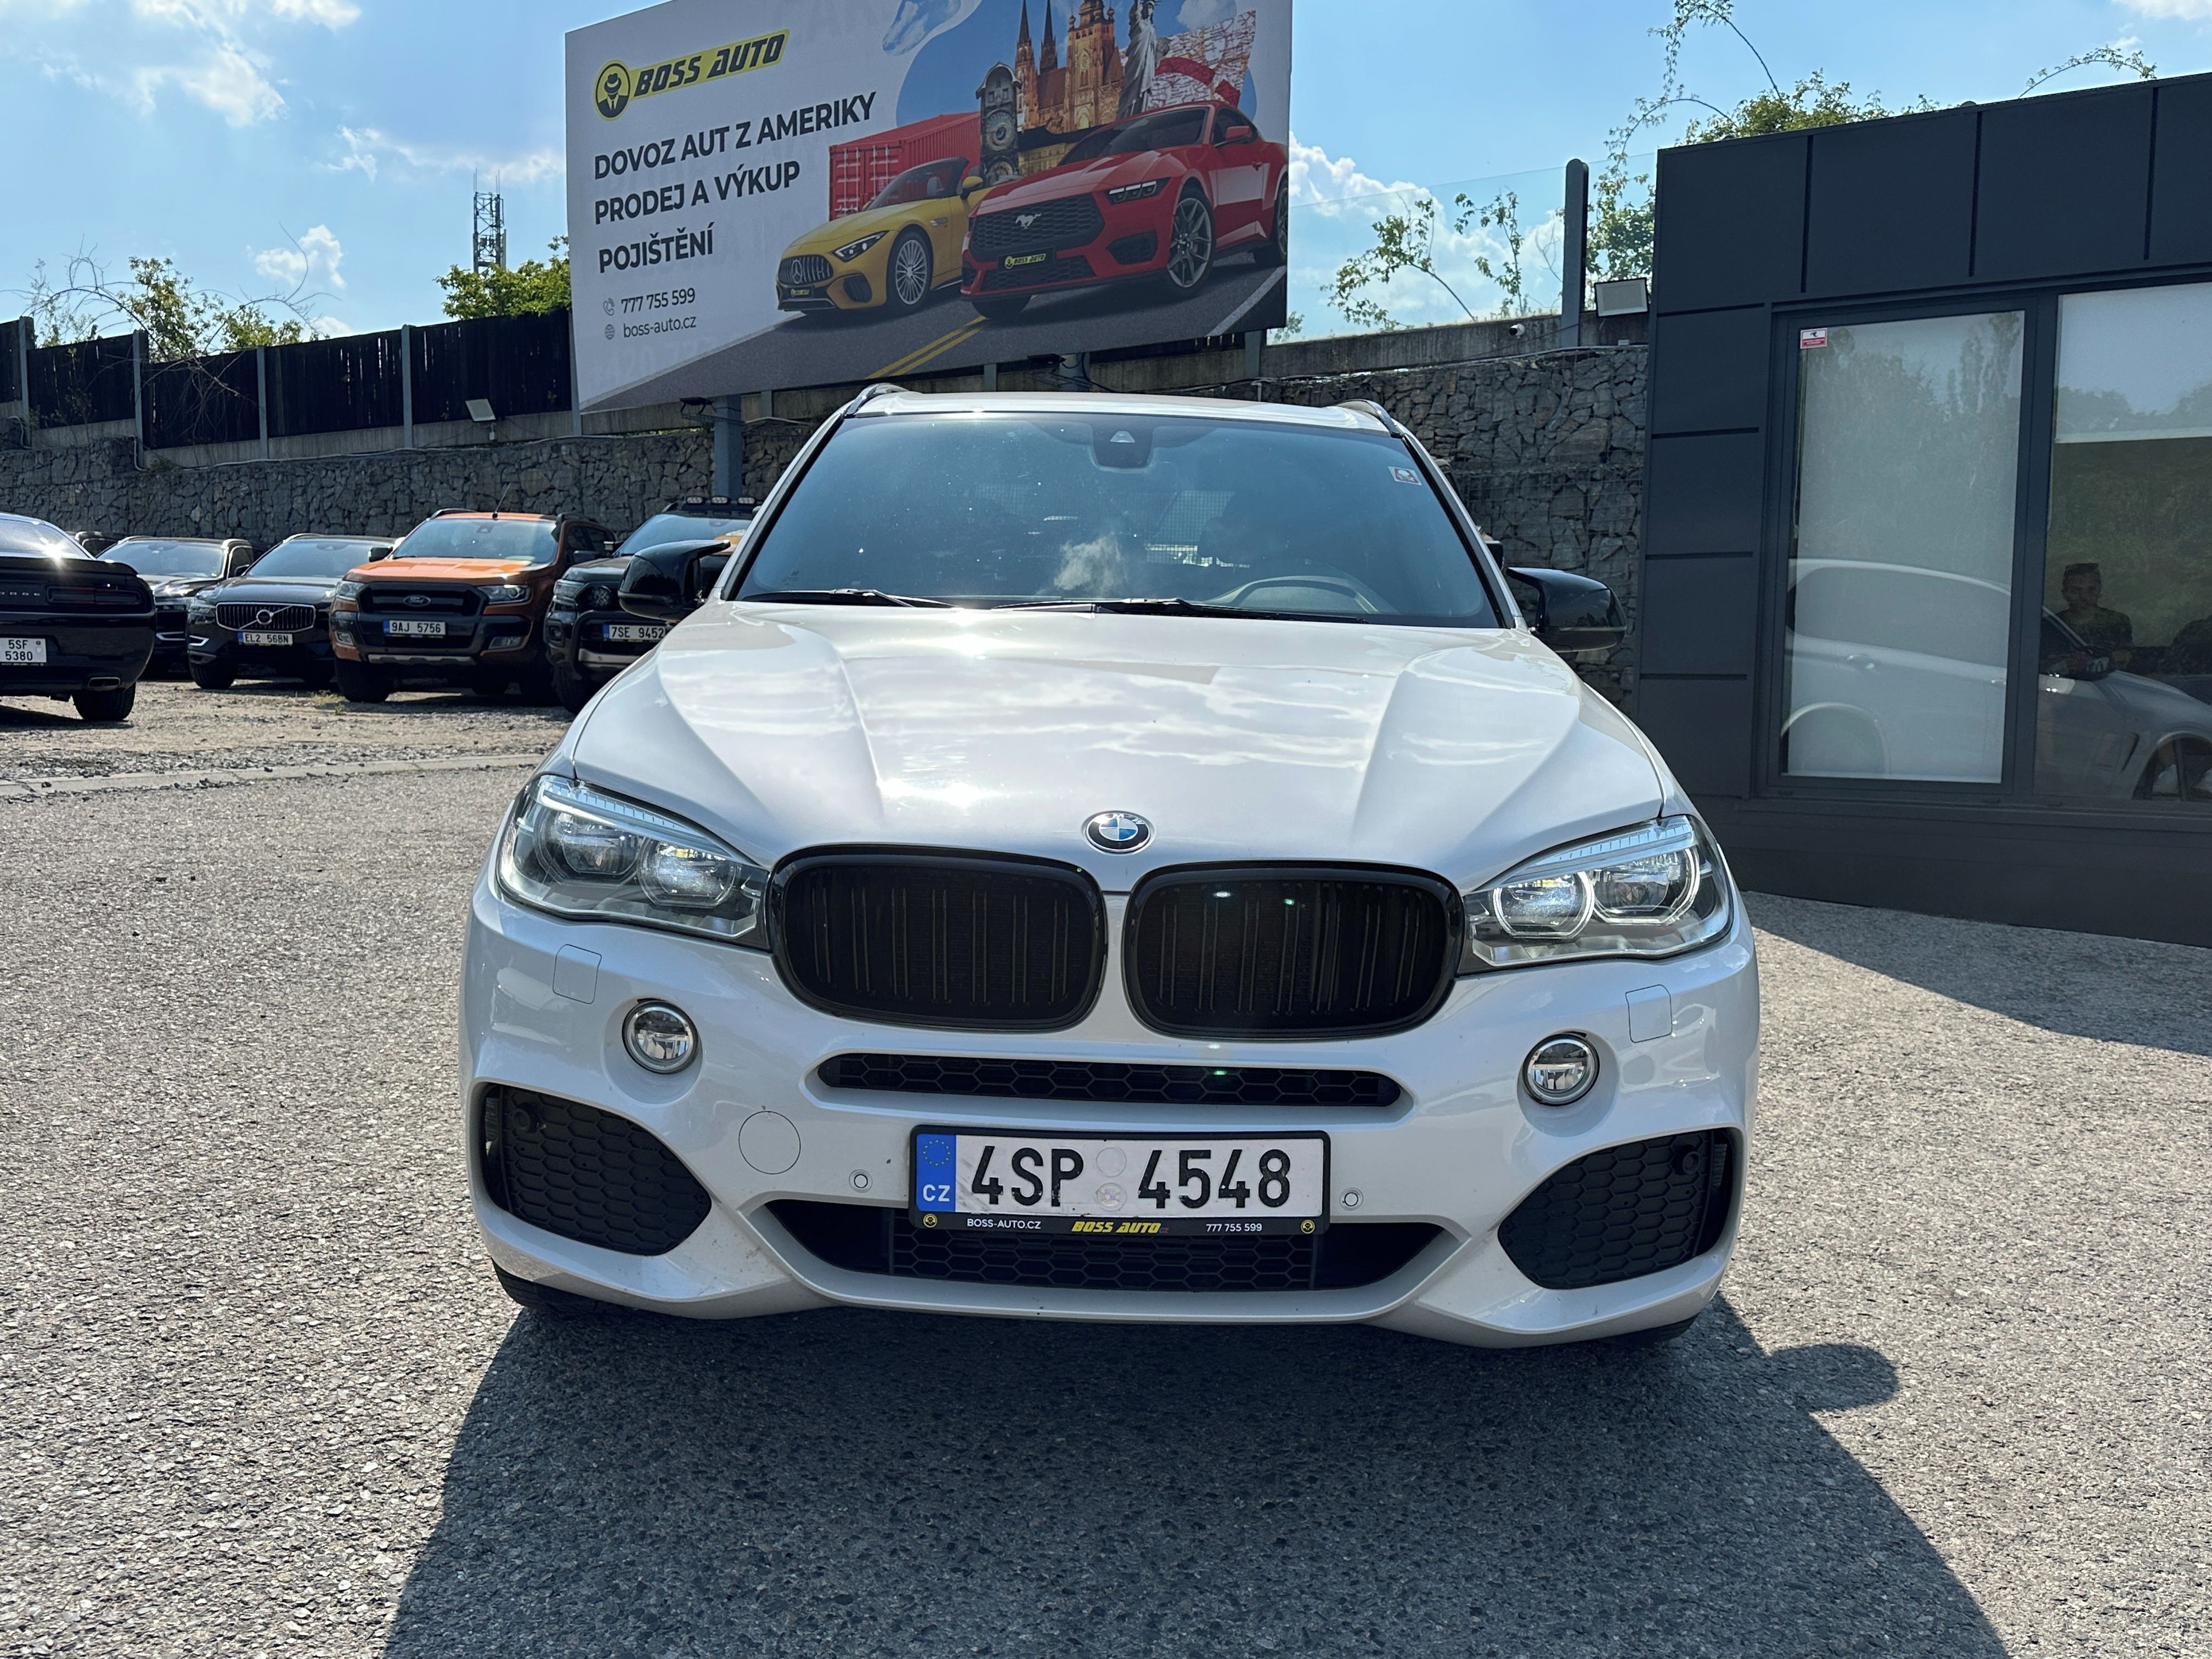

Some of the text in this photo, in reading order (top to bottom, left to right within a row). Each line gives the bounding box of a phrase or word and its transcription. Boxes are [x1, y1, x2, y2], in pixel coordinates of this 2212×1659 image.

[634, 34, 785, 97] BOSS AUTO
[595, 91, 877, 179] DOVOZ AUT Z AMERIKY
[595, 160, 800, 225] PRODEJ A VÝKUP
[599, 221, 715, 274] POJIŠTĚNÍ
[621, 287, 696, 313] 777 755 599
[623, 317, 697, 338] boss-auto.cz
[392, 622, 410, 632] 9AJ
[417, 623, 441, 633] 5756
[611, 627, 630, 637] 7SE
[639, 627, 664, 639] 9452
[8, 640, 29, 650] 5SF
[245, 634, 261, 642] EL2
[267, 634, 289, 643] 56BN
[5, 651, 33, 661] 5380
[972, 1146, 1291, 1209] 4SP 4548
[922, 1184, 951, 1202] CZ
[967, 1218, 1041, 1230] BOSS-AUTO.CZ
[1071, 1221, 1114, 1233] BOSS
[1115, 1222, 1162, 1234] AUTO
[1206, 1223, 1262, 1232] 777 755 599
